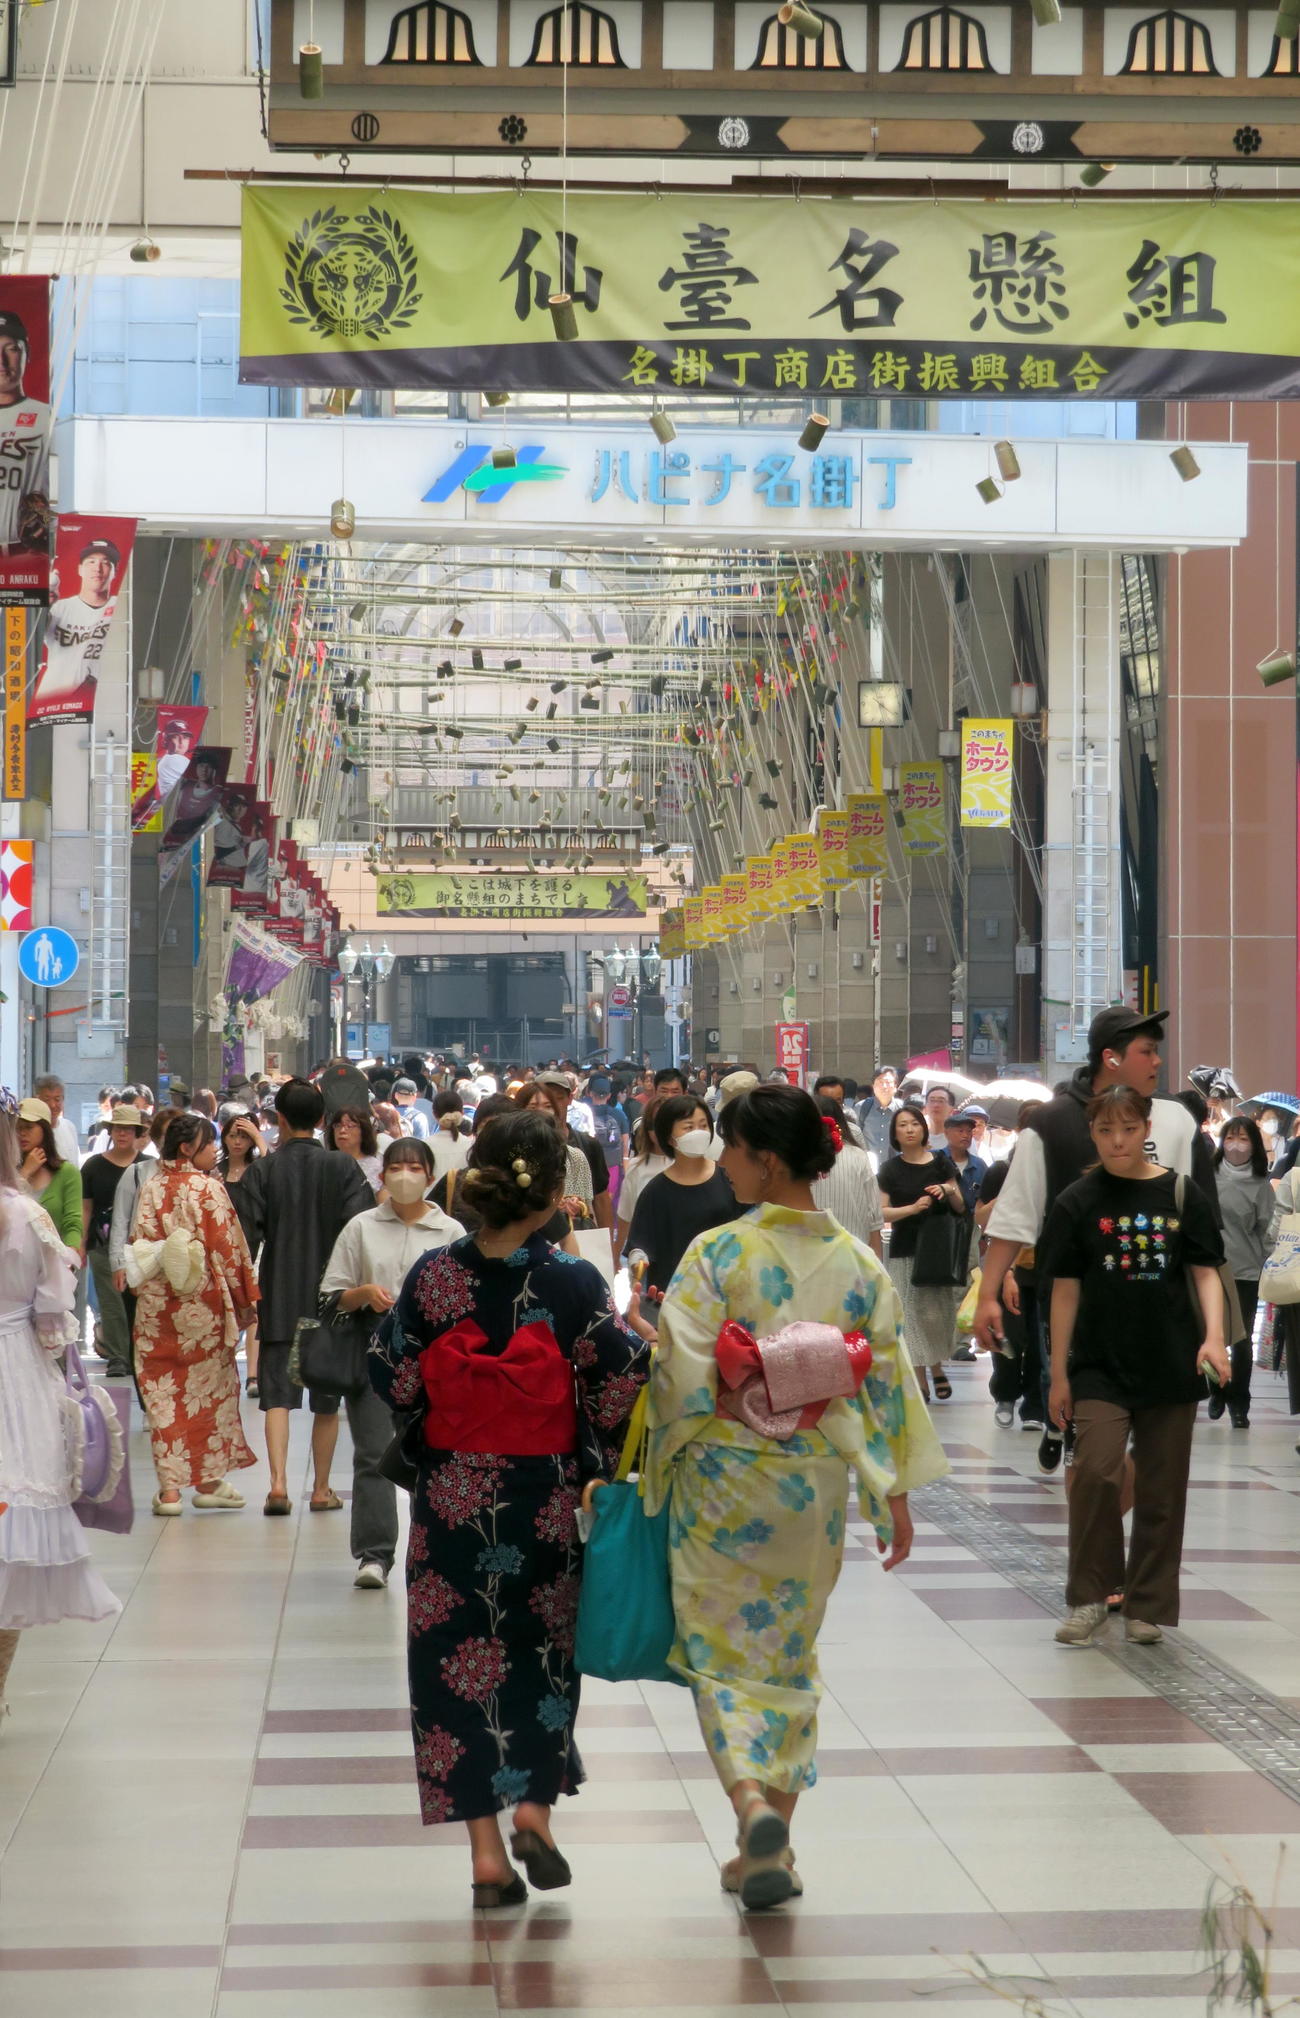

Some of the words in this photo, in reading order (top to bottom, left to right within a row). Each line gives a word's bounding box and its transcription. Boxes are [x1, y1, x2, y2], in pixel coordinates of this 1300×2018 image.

[500, 222, 1227, 335] 仙臺名懸組
[622, 345, 1108, 392] 名掛丁商店街振興組合
[591, 450, 912, 511] ハピナ名掛丁
[83, 643, 103, 660] 22
[966, 741, 1009, 757] ホーム
[966, 757, 1009, 772] タウン
[903, 781, 941, 795] ホーム
[903, 795, 941, 809] タウン
[850, 812, 884, 824] ホーム
[850, 824, 884, 836] タウン
[789, 849, 817, 860] ホーム
[789, 859, 818, 871] タウン
